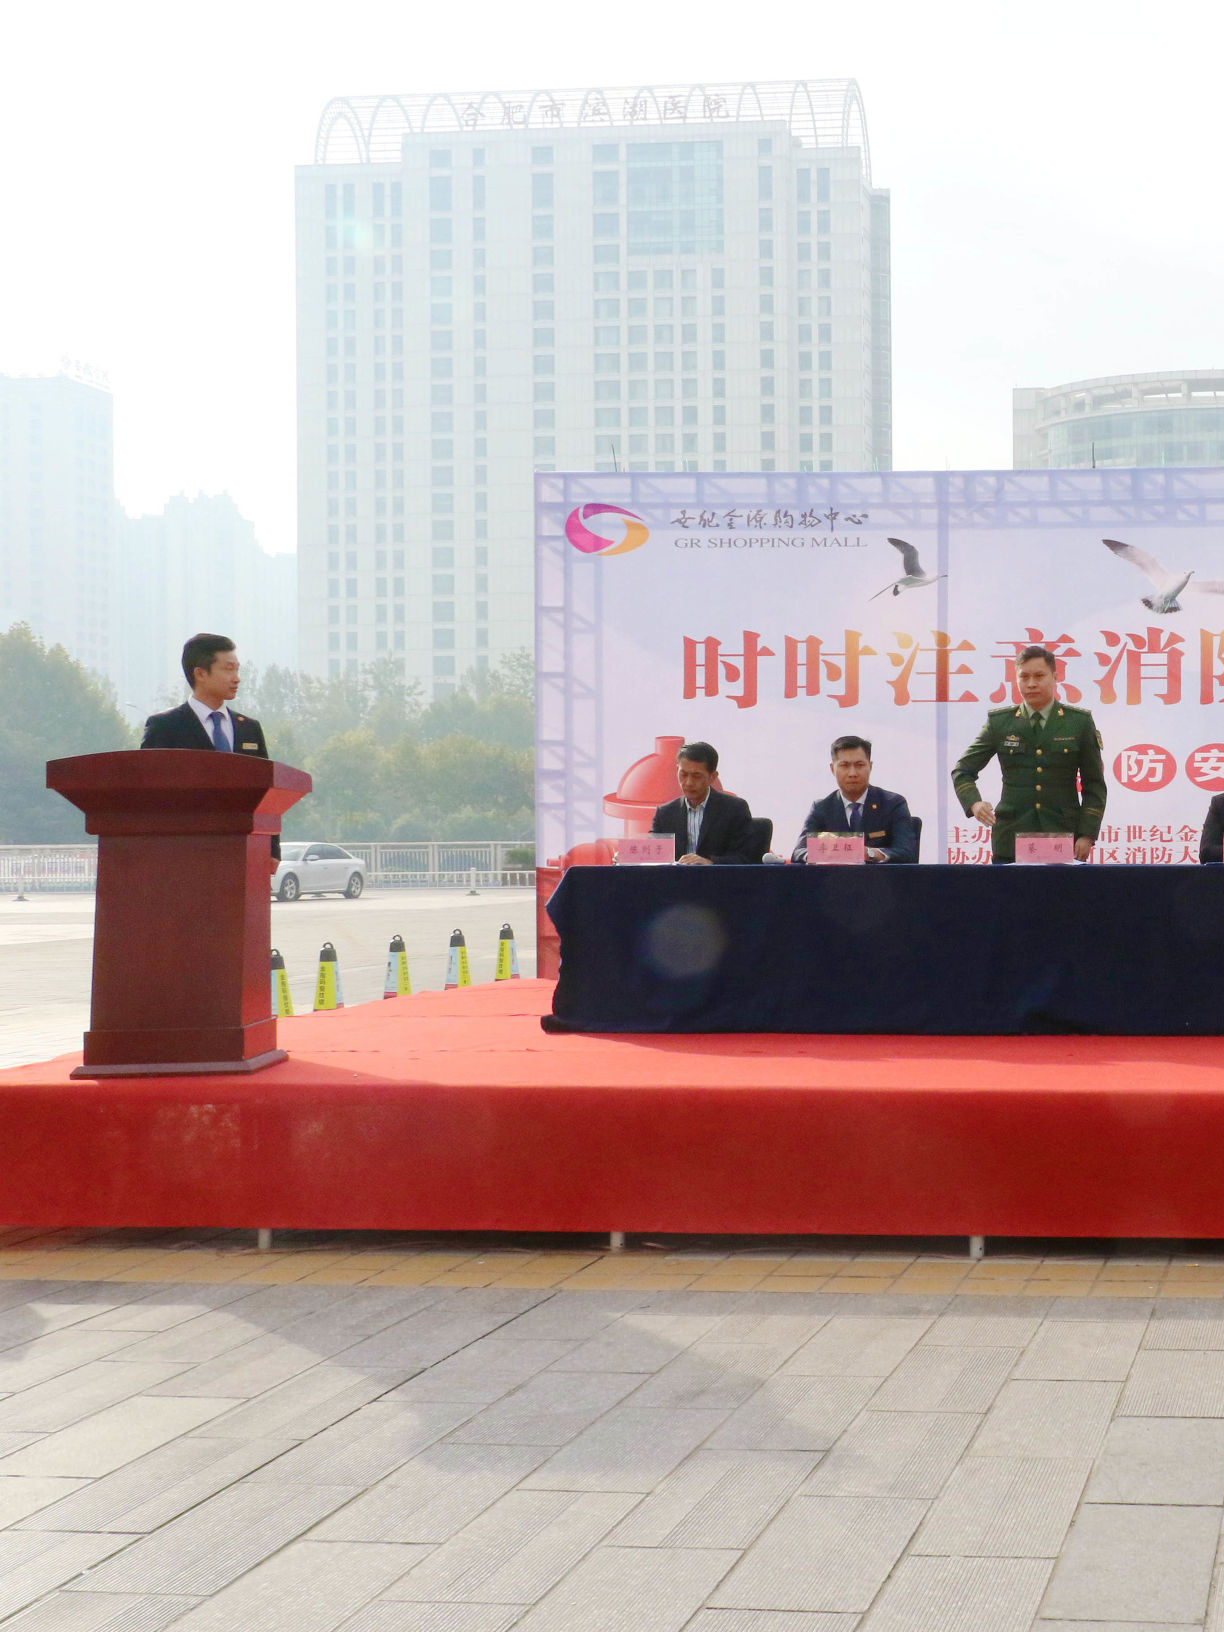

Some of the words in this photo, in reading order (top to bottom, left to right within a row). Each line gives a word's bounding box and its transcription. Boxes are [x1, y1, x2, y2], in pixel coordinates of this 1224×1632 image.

[459, 94, 731, 128] 合肥市滨湖医院
[674, 538, 702, 549] GR
[707, 537, 805, 549] SHOPPING
[811, 537, 868, 548] MALL
